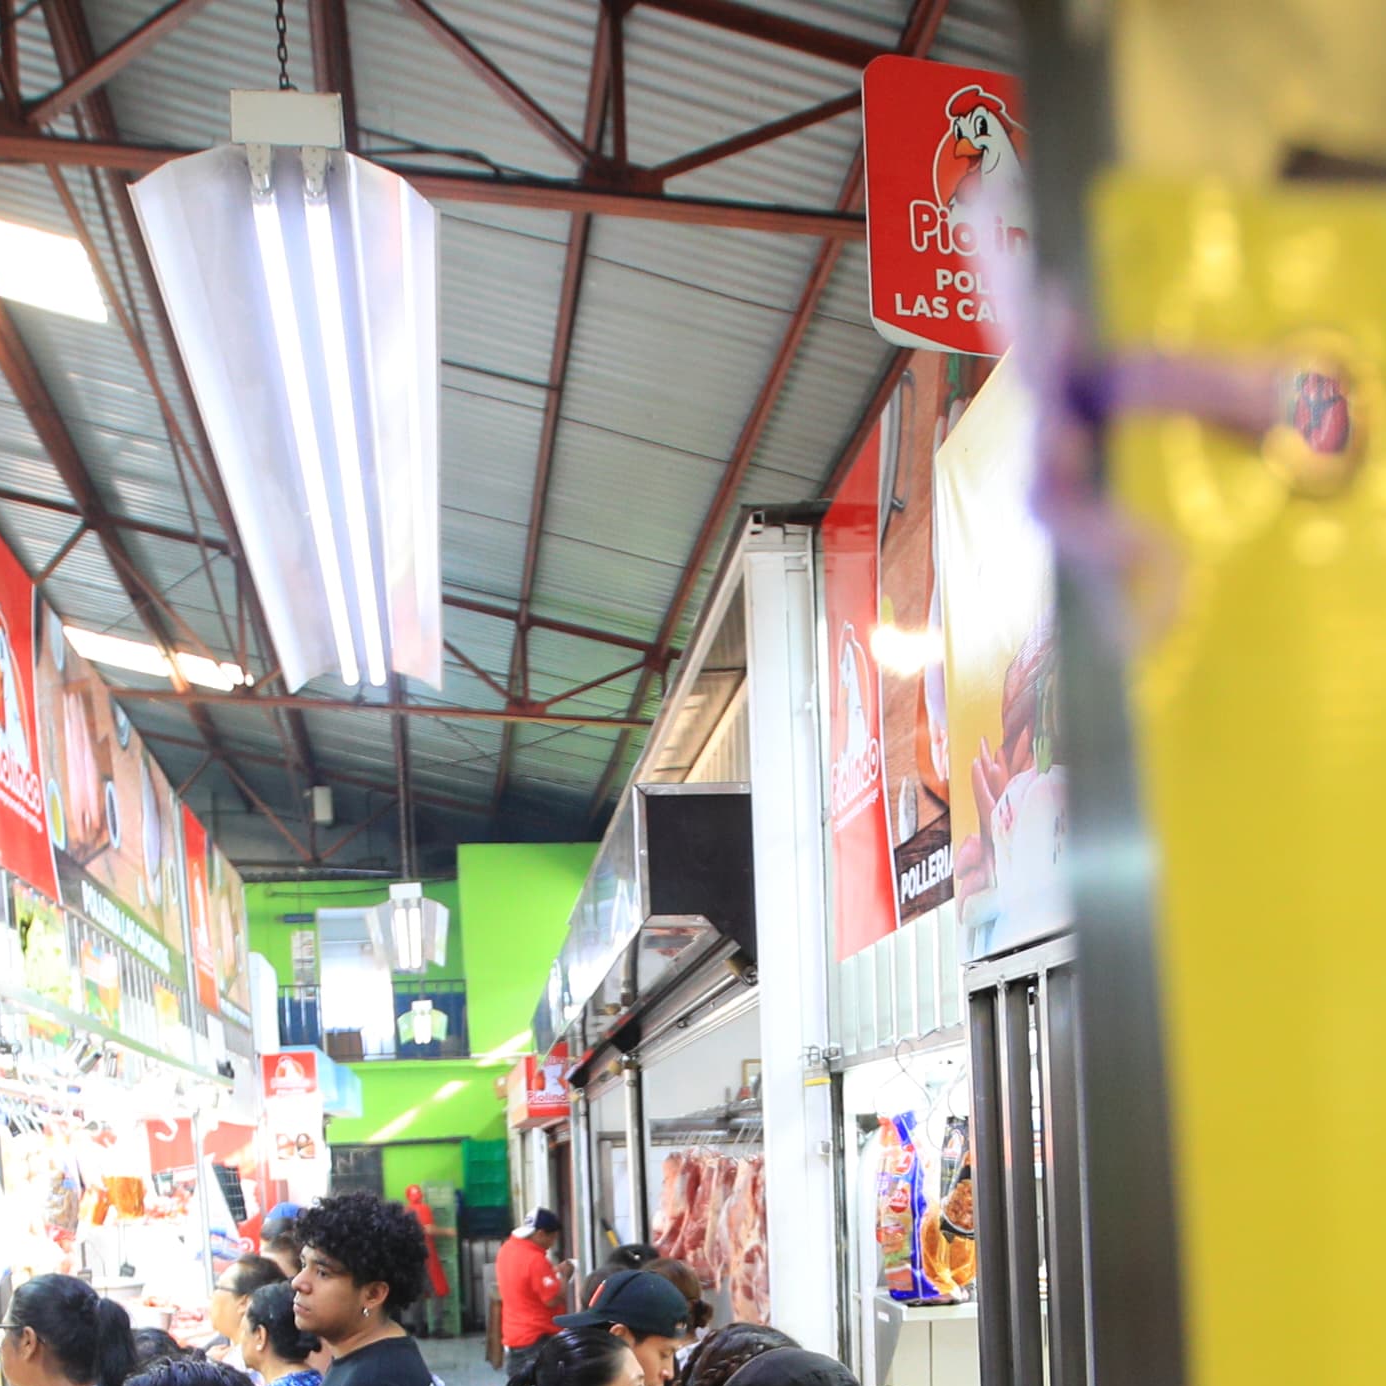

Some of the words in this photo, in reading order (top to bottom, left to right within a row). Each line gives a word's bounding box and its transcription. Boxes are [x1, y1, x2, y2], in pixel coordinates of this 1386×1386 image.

[936, 269, 991, 294] POL
[895, 293, 950, 319] LAS
[956, 298, 999, 322] CA
[900, 845, 954, 904] POLLERIA
